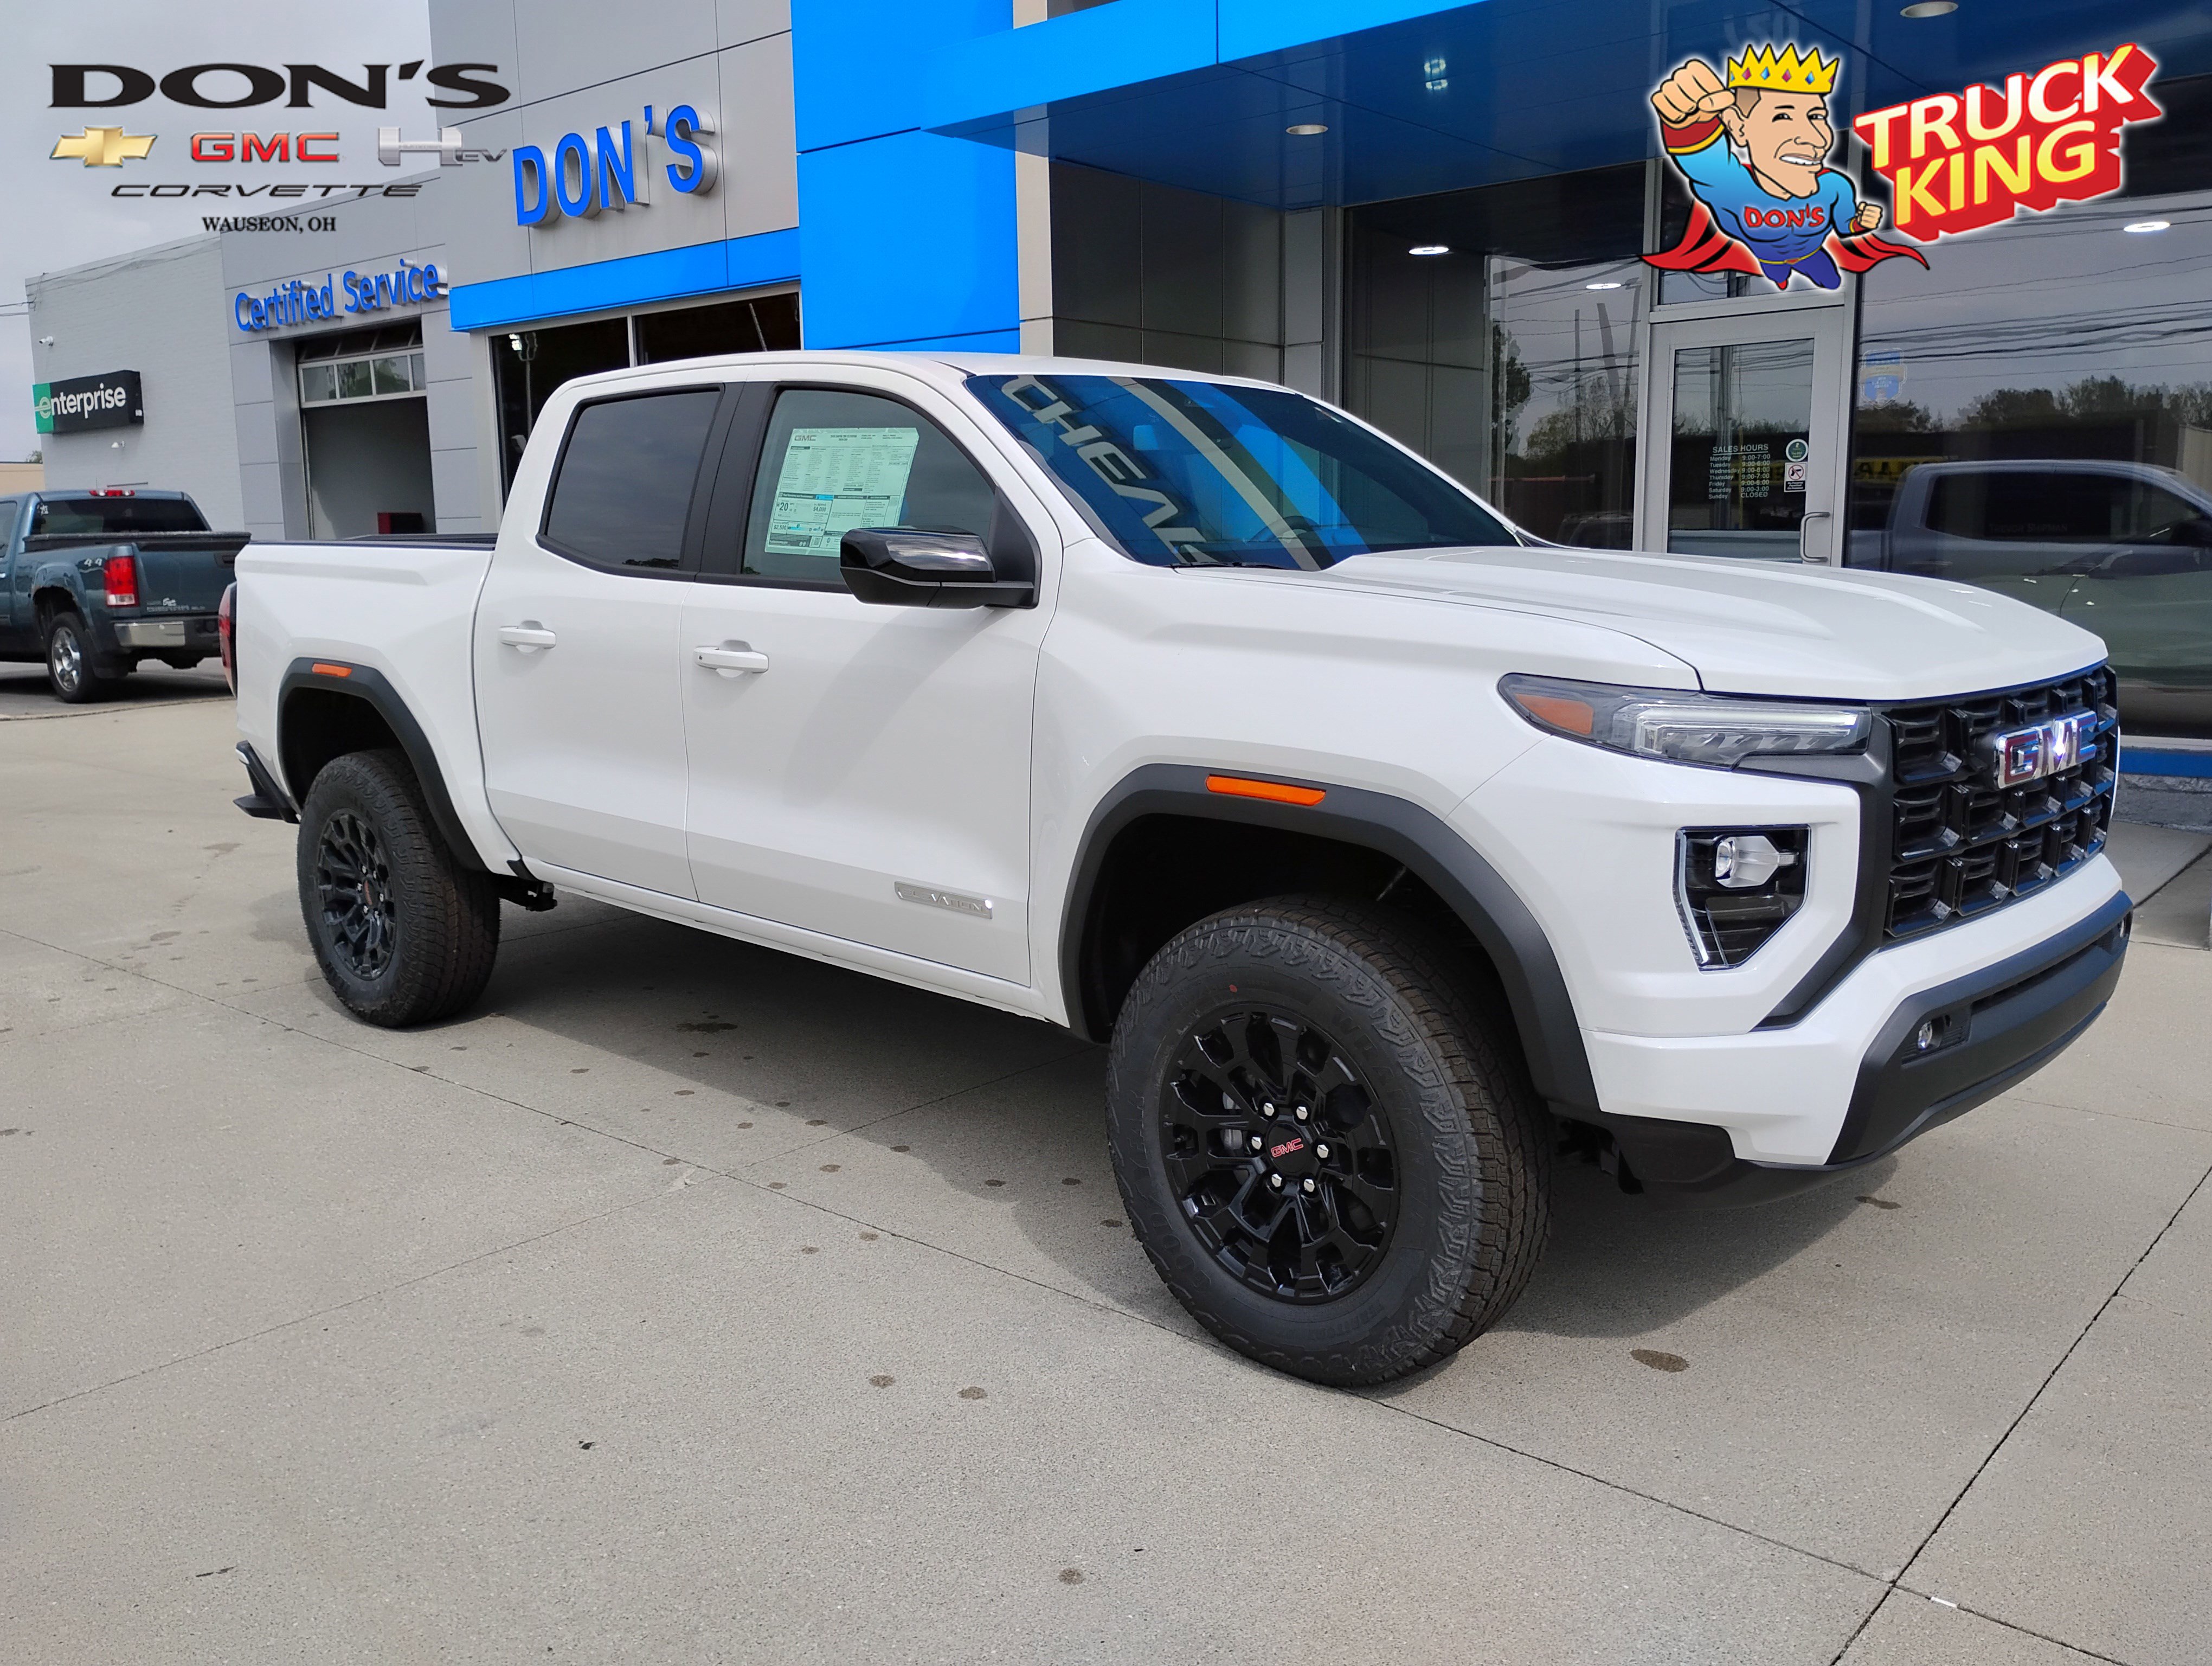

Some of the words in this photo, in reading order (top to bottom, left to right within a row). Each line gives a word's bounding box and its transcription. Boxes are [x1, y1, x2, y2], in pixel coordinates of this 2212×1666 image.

[512, 104, 708, 227] DON'S
[235, 273, 336, 331] Certified
[343, 258, 440, 313] Service
[35, 382, 126, 419] enterprise
[1712, 445, 1739, 453] SALES
[1740, 444, 1769, 452] HOURS
[779, 502, 789, 511] 20
[1994, 710, 2098, 790] GMC
[1271, 1138, 1304, 1157] GMC
